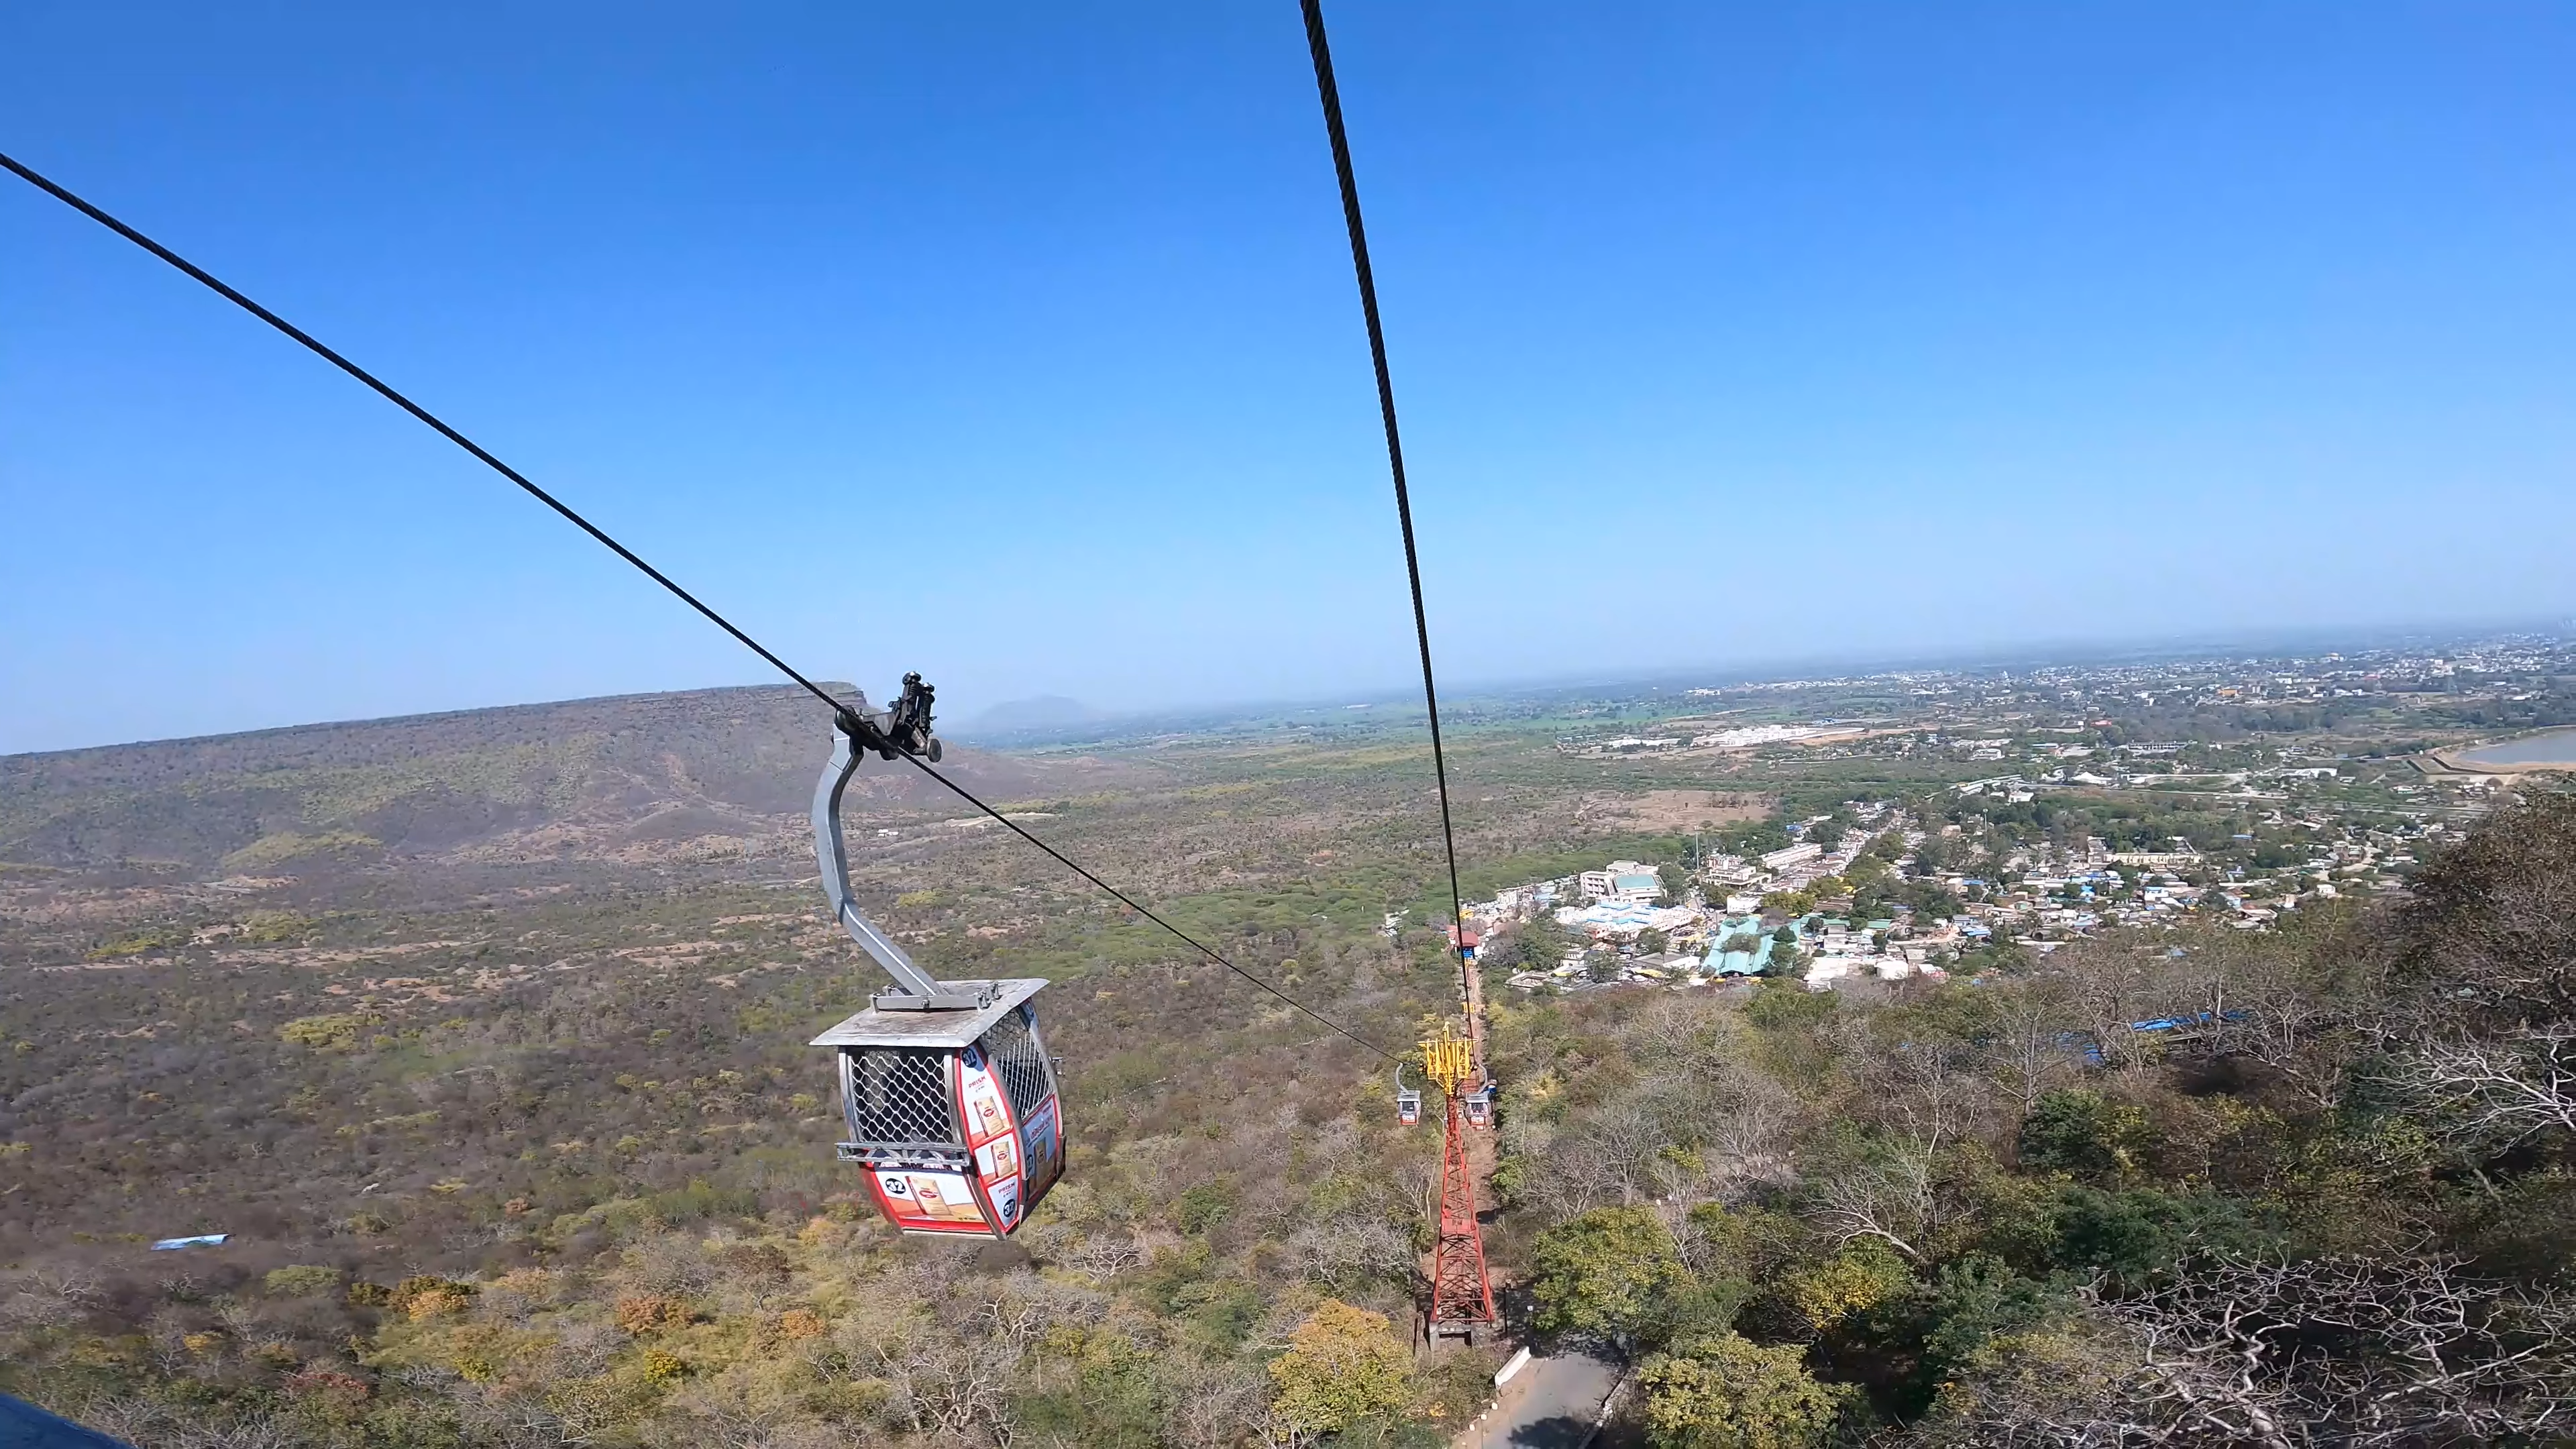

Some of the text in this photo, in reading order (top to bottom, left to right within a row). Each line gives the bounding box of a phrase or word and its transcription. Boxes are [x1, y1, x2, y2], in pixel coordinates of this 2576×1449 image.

[963, 1050, 976, 1065] 32
[968, 1075, 986, 1088] PRISM
[886, 1181, 905, 1191] 32
[1004, 1201, 1014, 1215] 32
